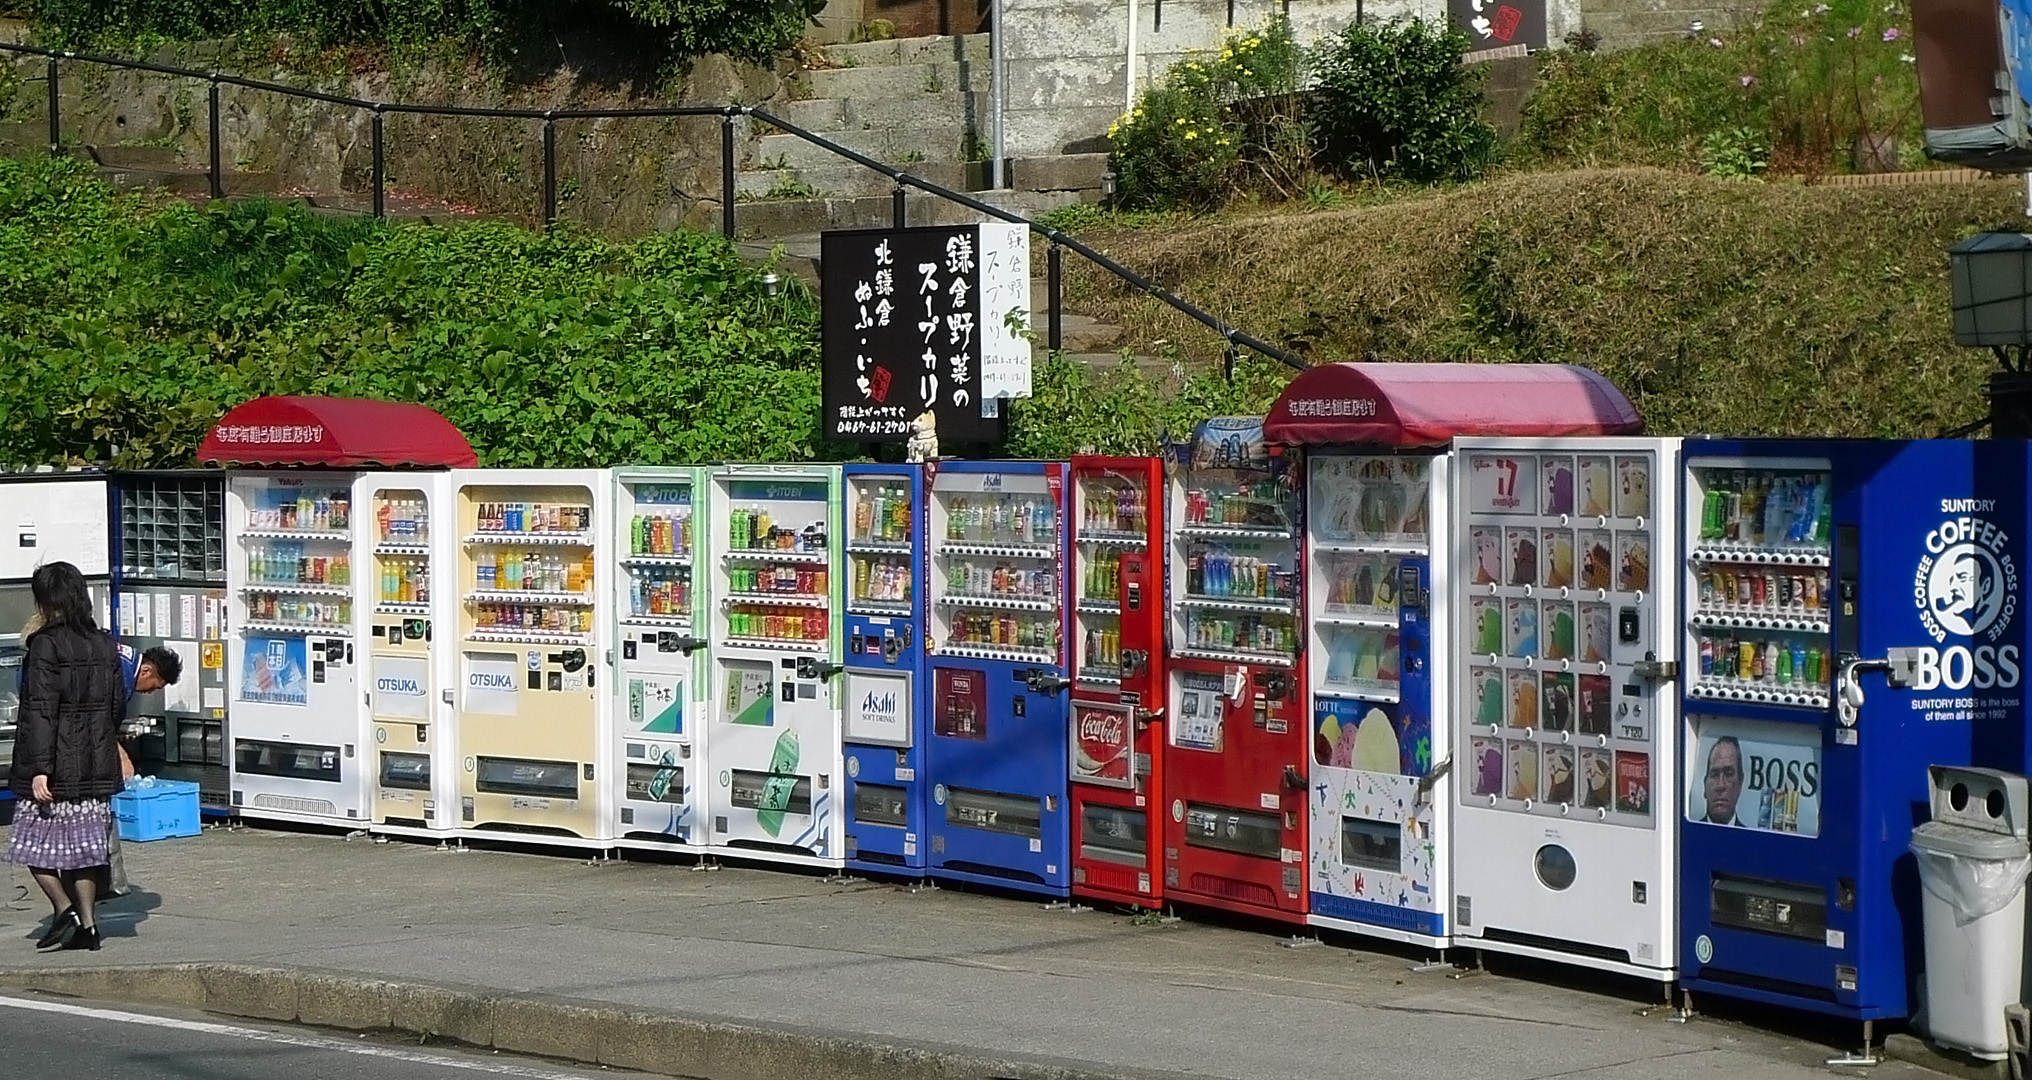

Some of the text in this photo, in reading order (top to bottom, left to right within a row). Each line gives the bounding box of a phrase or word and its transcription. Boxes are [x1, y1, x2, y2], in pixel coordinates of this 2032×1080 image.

[874, 238, 894, 327] 北鎌倉
[945, 233, 975, 408] 鎌倉野菜の
[854, 280, 873, 399] ぬふ・いち
[837, 420, 910, 434] 0467-61-2701
[1941, 499, 1996, 513] SUNTORY
[1926, 517, 2009, 555] COFFEE
[1914, 554, 1947, 643] BOSS COFFEE
[1987, 554, 2018, 643] BOSS COFFEE
[1912, 644, 2020, 691] BOSS
[377, 678, 418, 692] OTSUKA
[470, 673, 512, 687] OTSUKA
[862, 690, 896, 714] Asahi
[1315, 701, 1339, 713] LOTTE
[1911, 697, 2020, 709] SUNTORY BOSS is the boss
[875, 714, 896, 723] DRINKS
[1925, 709, 2007, 721] of them all since 1992
[1748, 755, 1819, 798] BOSS
